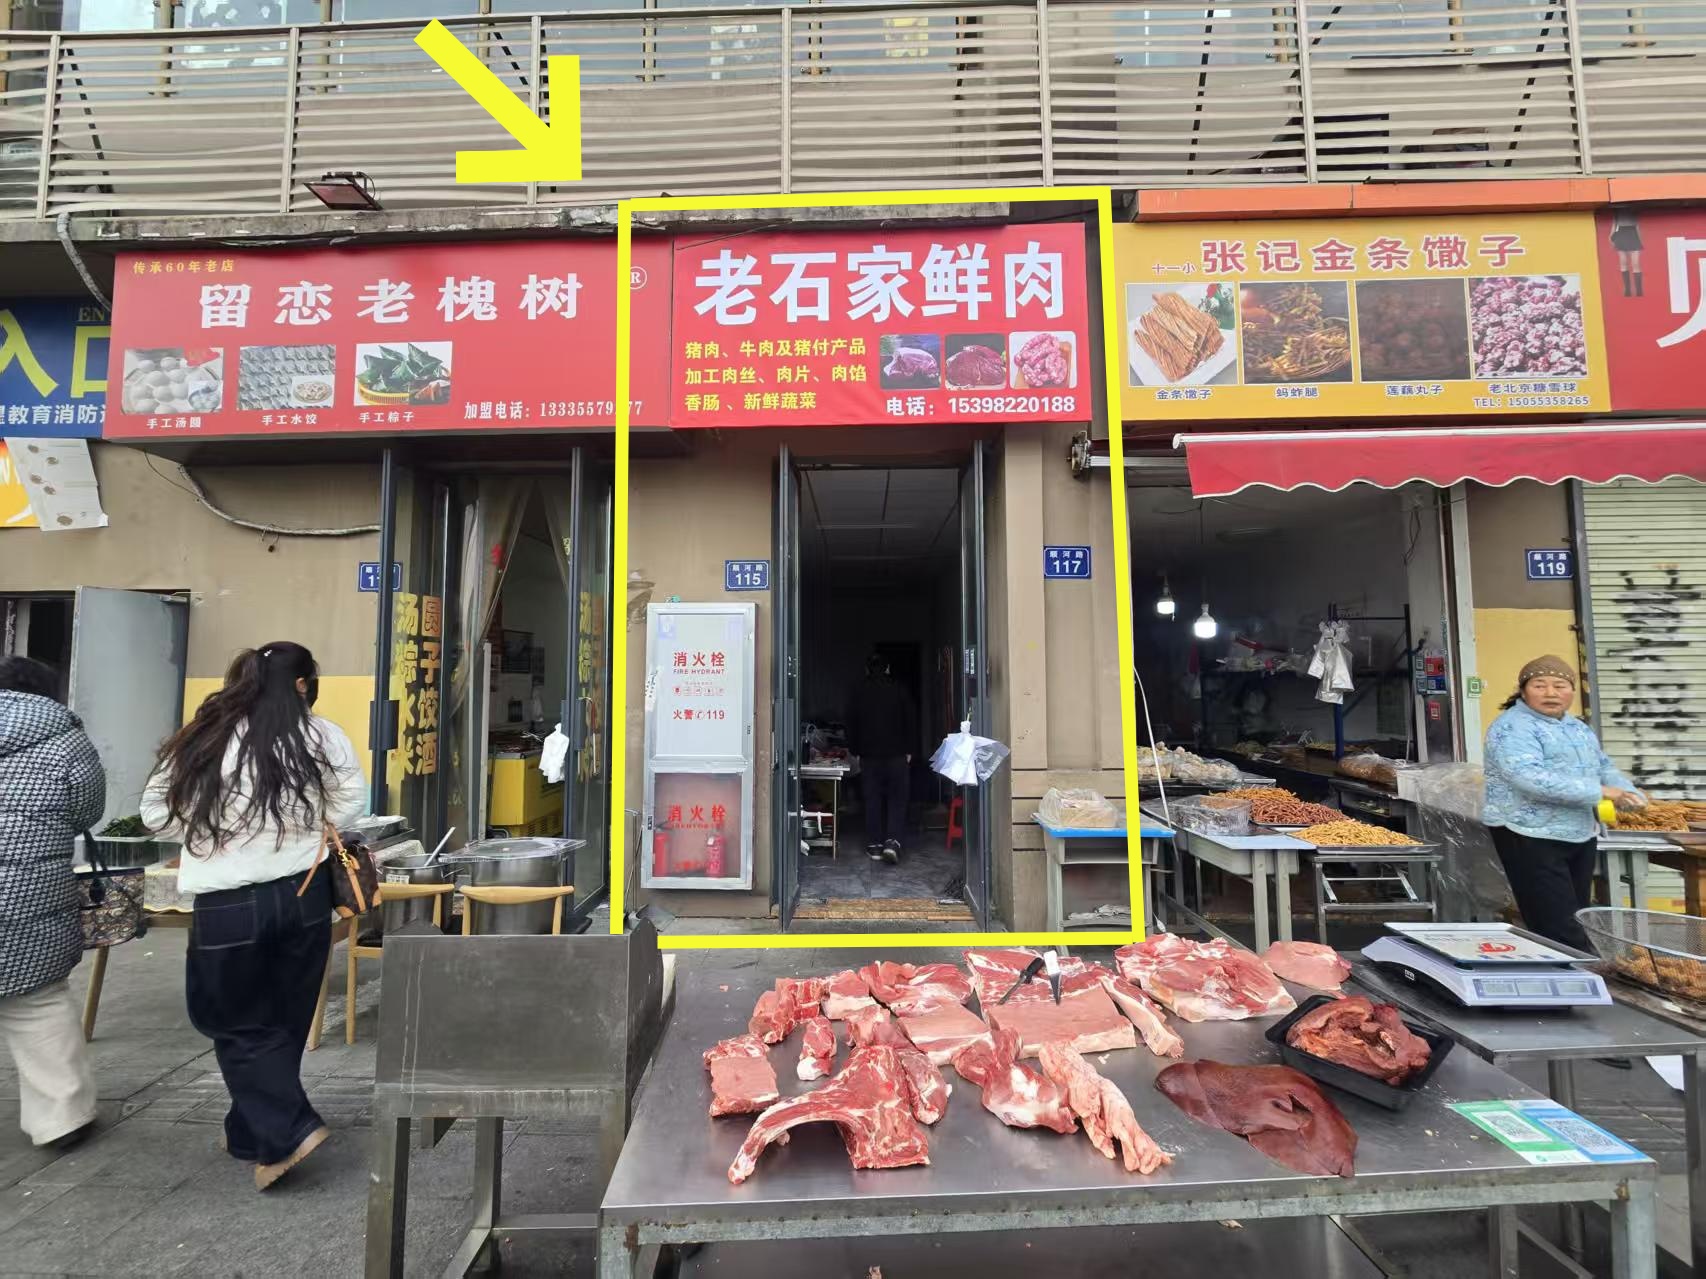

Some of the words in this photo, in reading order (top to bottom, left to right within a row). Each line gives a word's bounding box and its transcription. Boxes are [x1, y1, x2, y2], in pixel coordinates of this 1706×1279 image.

[1201, 234, 1525, 274] 张记金条馓子
[133, 260, 234, 274] 传承60年老店
[693, 240, 1065, 325] 老石家鲜肉
[199, 273, 583, 328] 留恋老槐树
[685, 338, 866, 359] 猪肉、牛肉及猪付产品
[685, 364, 867, 385] 加工肉丝、肉片、肉馅
[1157, 389, 1212, 400] 金条馓子
[1276, 387, 1318, 397] 蚂蚱腿
[1387, 385, 1443, 396] 莲藕丸子
[1489, 382, 1577, 393] 老北京糖雪球
[684, 392, 817, 411] 香肠、新鲜蔬菜
[948, 396, 1075, 414] 15398220188
[1508, 395, 1589, 408] 15055358265
[0, 404, 107, 425] 教育消防
[262, 413, 317, 426] 手工水饺
[359, 411, 414, 423] 手工粽子
[147, 416, 201, 429] 手工汤圆
[1053, 560, 1081, 574] 117
[1537, 562, 1566, 575] 119
[735, 573, 761, 585] 115
[673, 651, 725, 667] 消火栓
